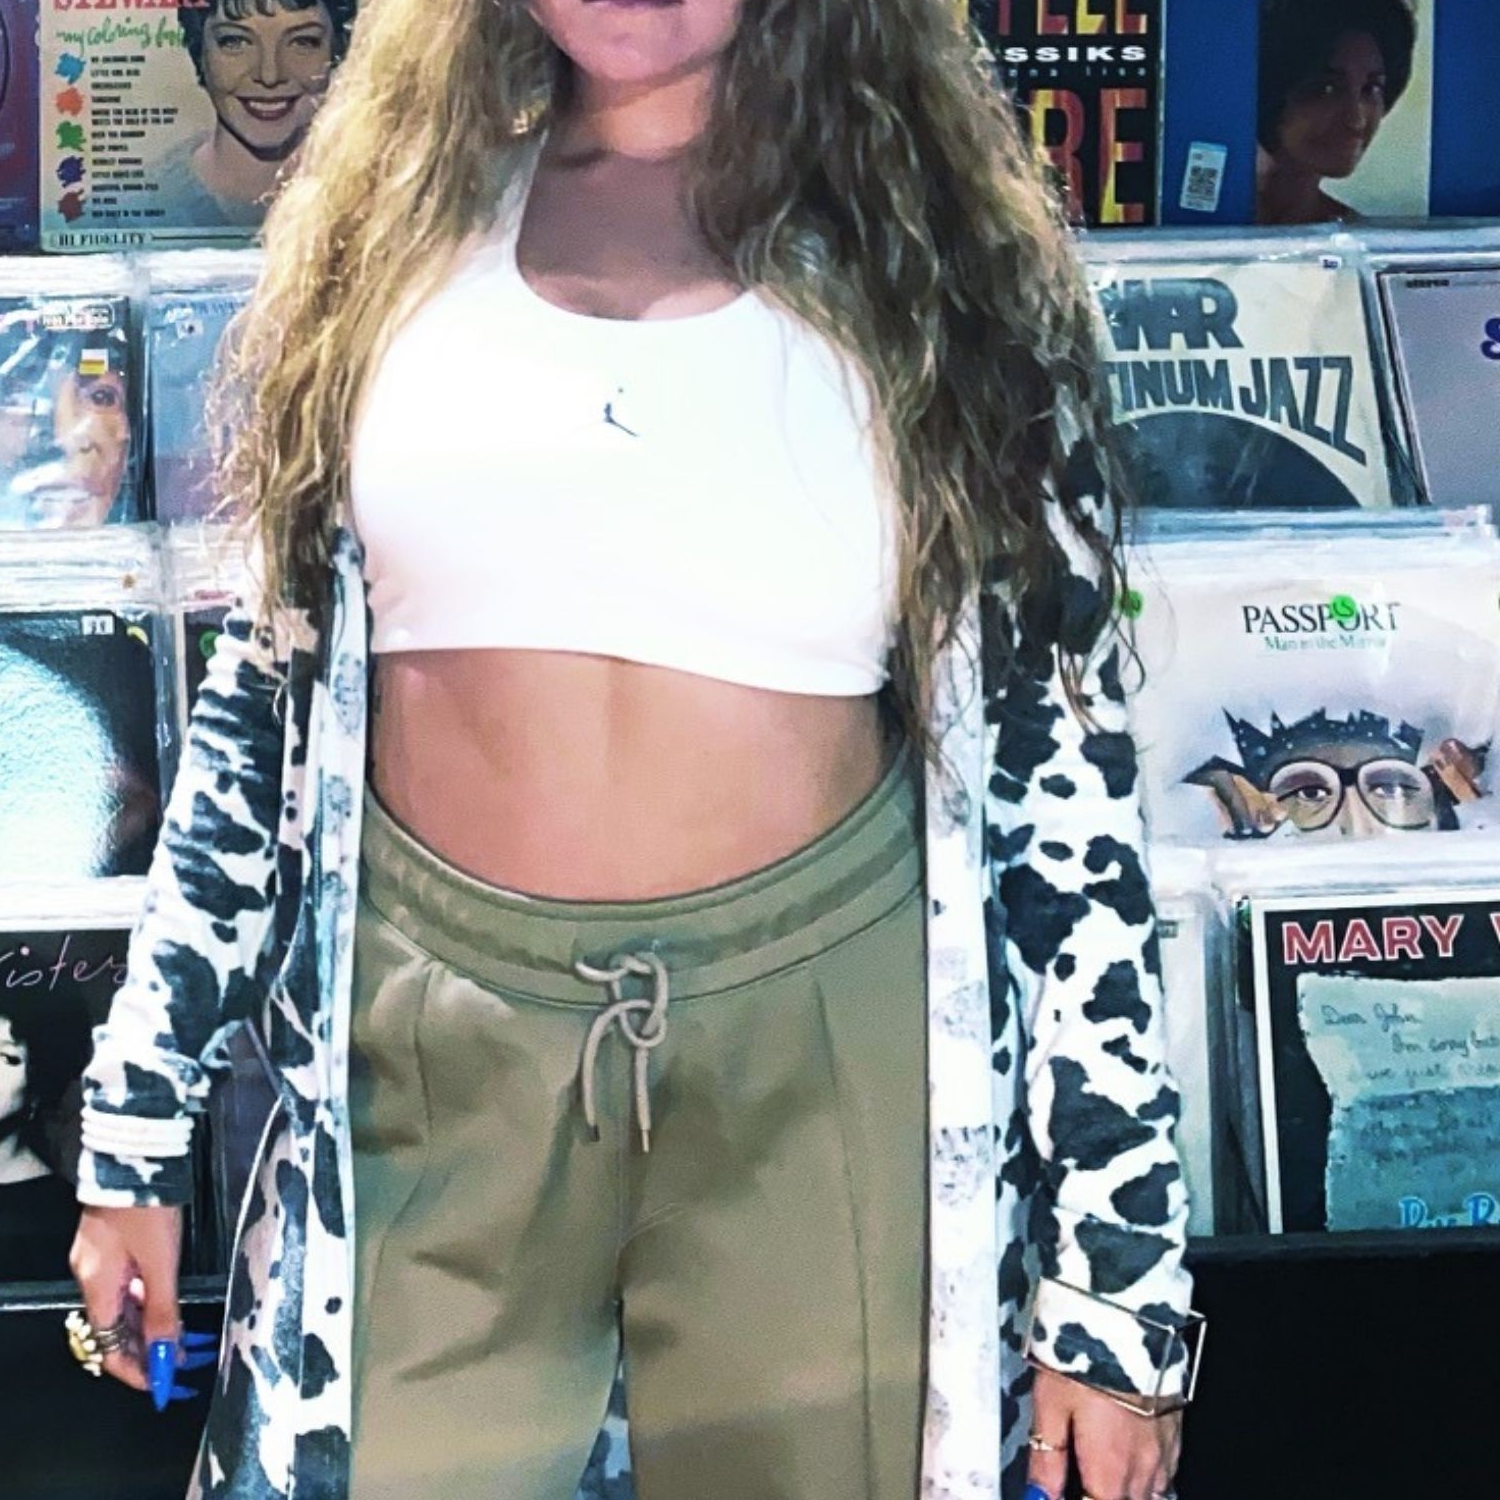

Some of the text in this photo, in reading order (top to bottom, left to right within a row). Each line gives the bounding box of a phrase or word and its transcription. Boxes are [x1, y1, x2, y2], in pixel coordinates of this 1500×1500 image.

[80, 232, 146, 247] FIDELITY
[1239, 356, 1368, 467] JAZZ
[1282, 913, 1465, 965] MARY
